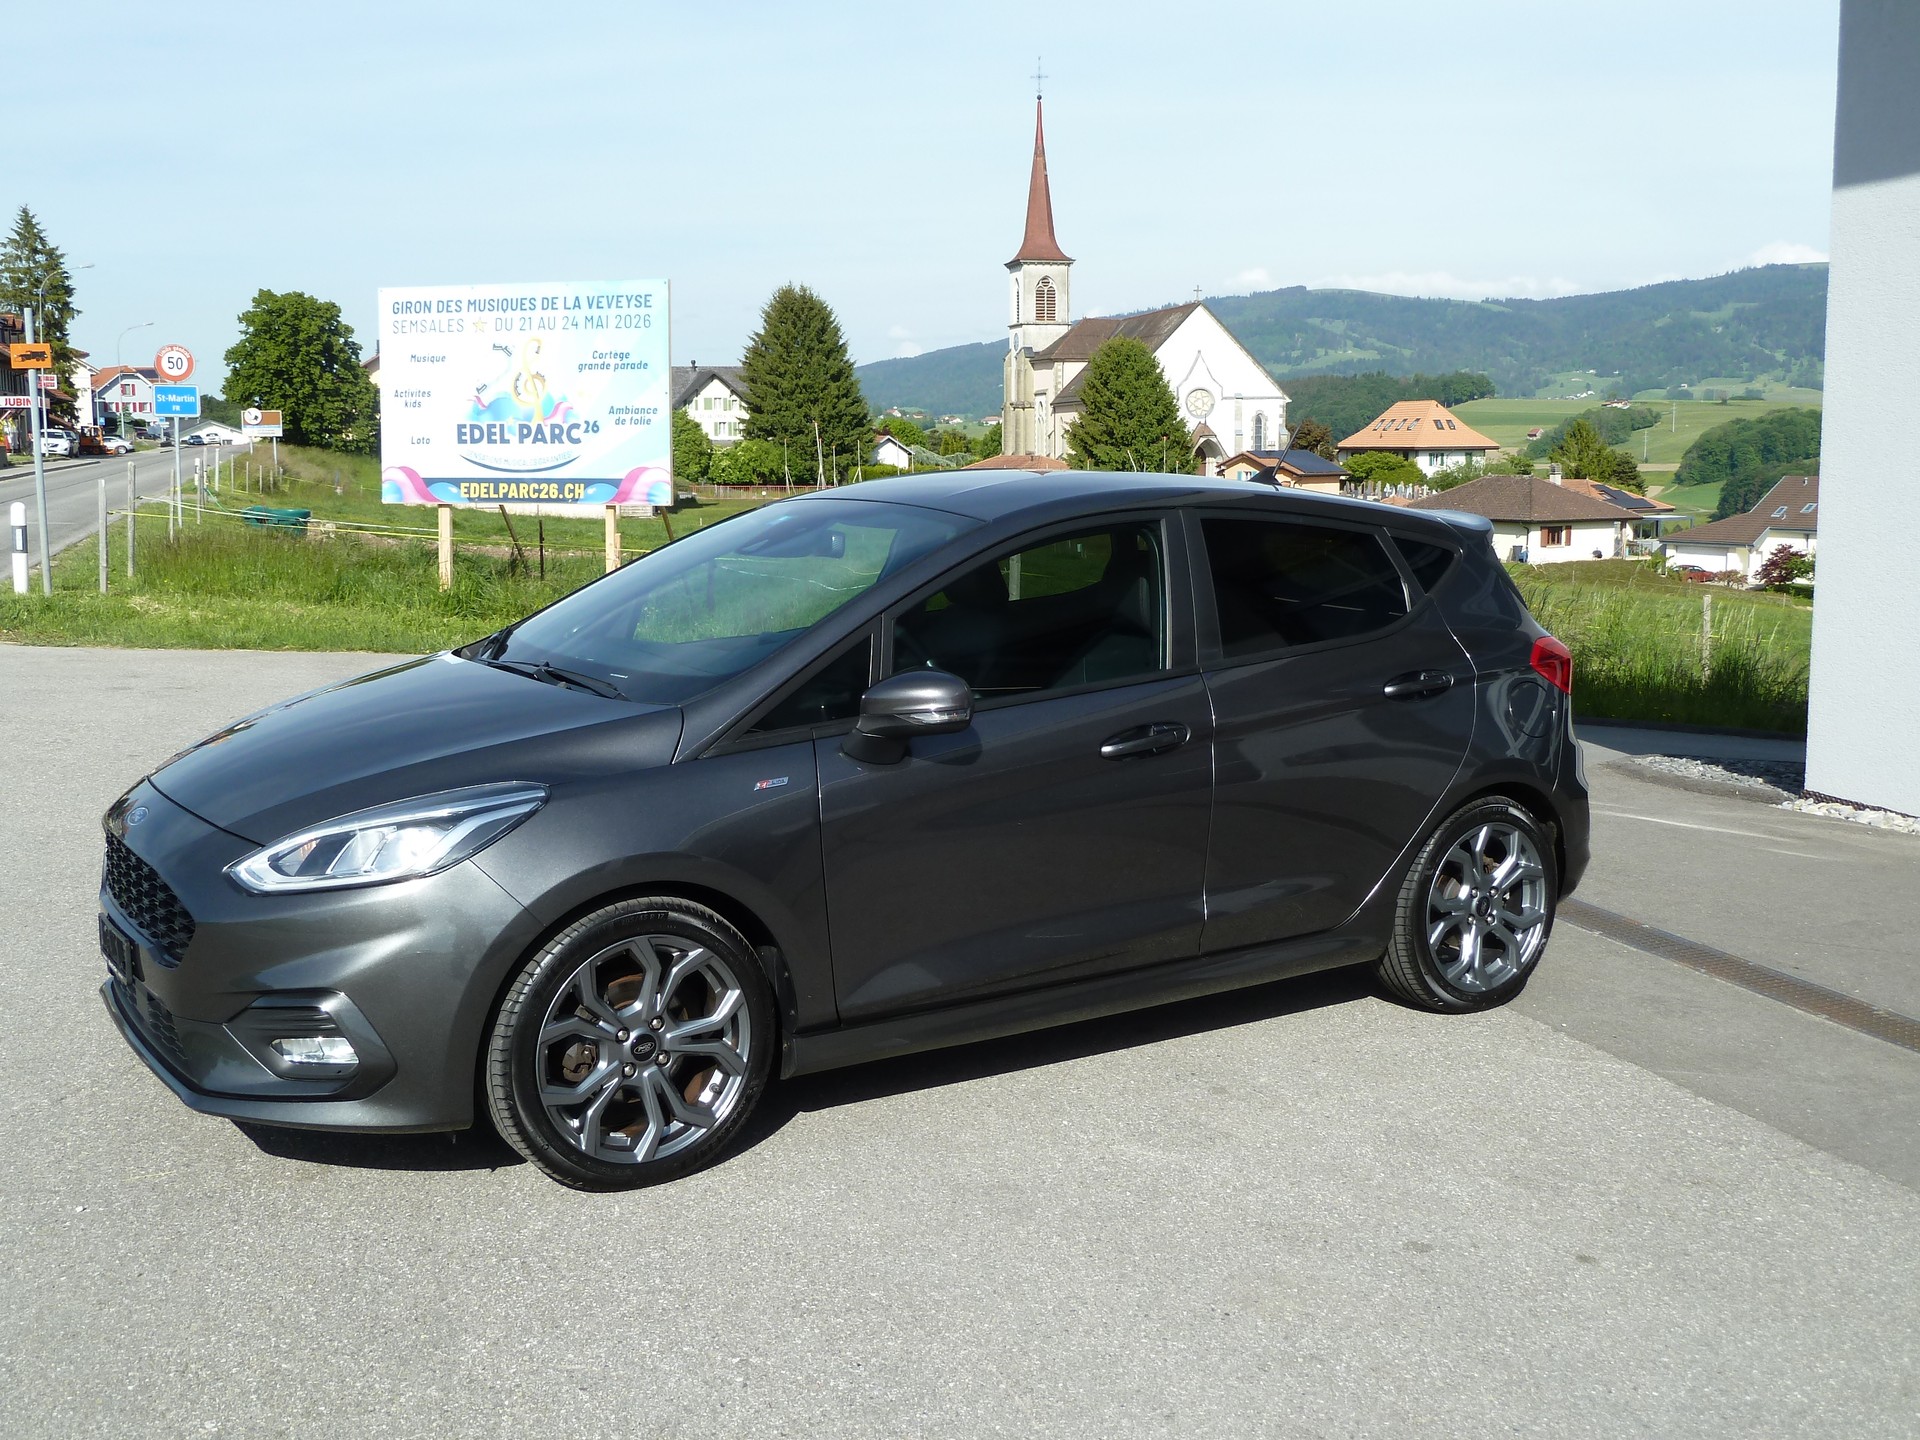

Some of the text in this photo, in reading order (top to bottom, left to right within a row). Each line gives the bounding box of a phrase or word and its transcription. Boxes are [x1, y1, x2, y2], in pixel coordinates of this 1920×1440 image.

[392, 294, 653, 315] GIRON DES MUSIQUES DE LA VEVEYSE
[392, 314, 651, 334] SEMSALES DU 21 AU 24 MAI 2026
[167, 356, 183, 371] 50
[410, 353, 446, 364] Musique
[578, 360, 649, 372] grande parade
[157, 394, 195, 403] St-Martin
[404, 399, 422, 408] kids
[608, 405, 658, 415] Ambiance
[614, 416, 652, 425] de folie
[457, 420, 600, 444] EDEL PARC 26
[411, 436, 431, 445] Loto
[460, 482, 585, 499] EDELPARC26.CH
